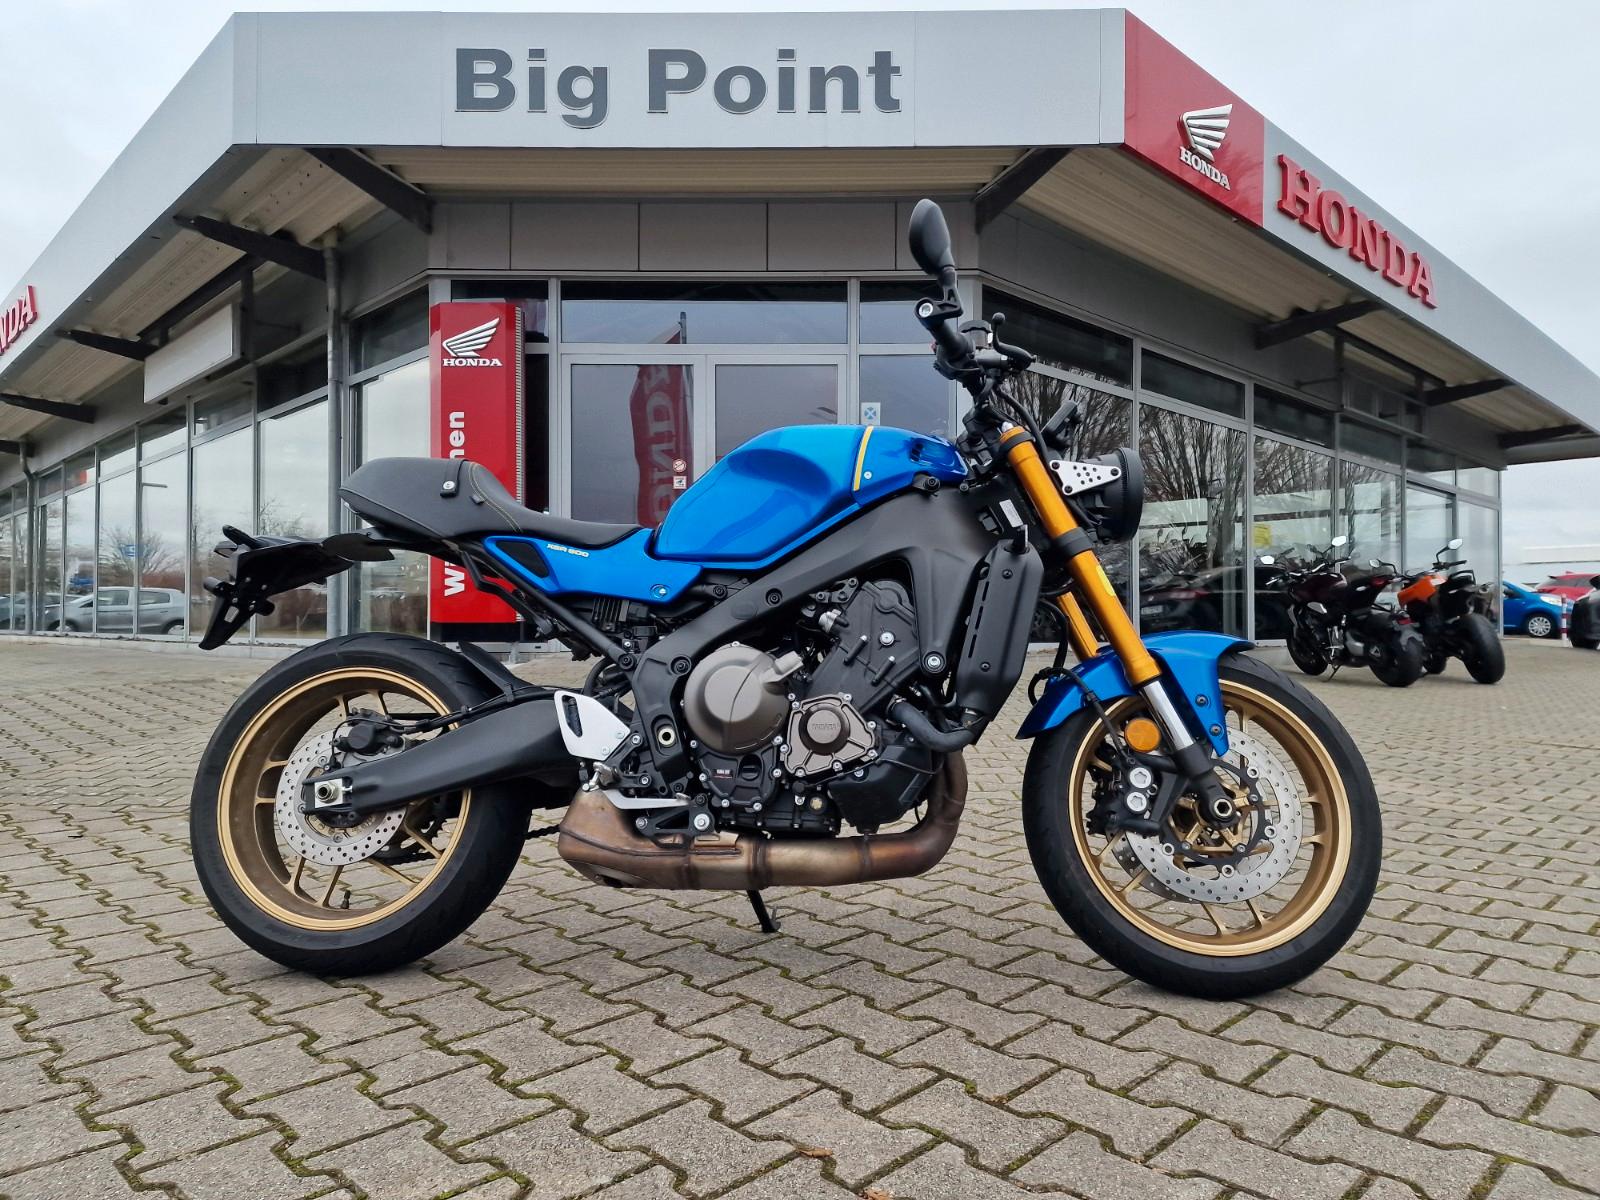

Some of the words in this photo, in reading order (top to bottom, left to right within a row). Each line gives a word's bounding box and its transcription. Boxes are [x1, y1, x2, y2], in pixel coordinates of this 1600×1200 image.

[455, 47, 609, 130] Big
[647, 47, 902, 115] Point
[1179, 146, 1231, 191] HONDA
[1276, 153, 1438, 309] HONDA
[442, 358, 503, 367] HONDA
